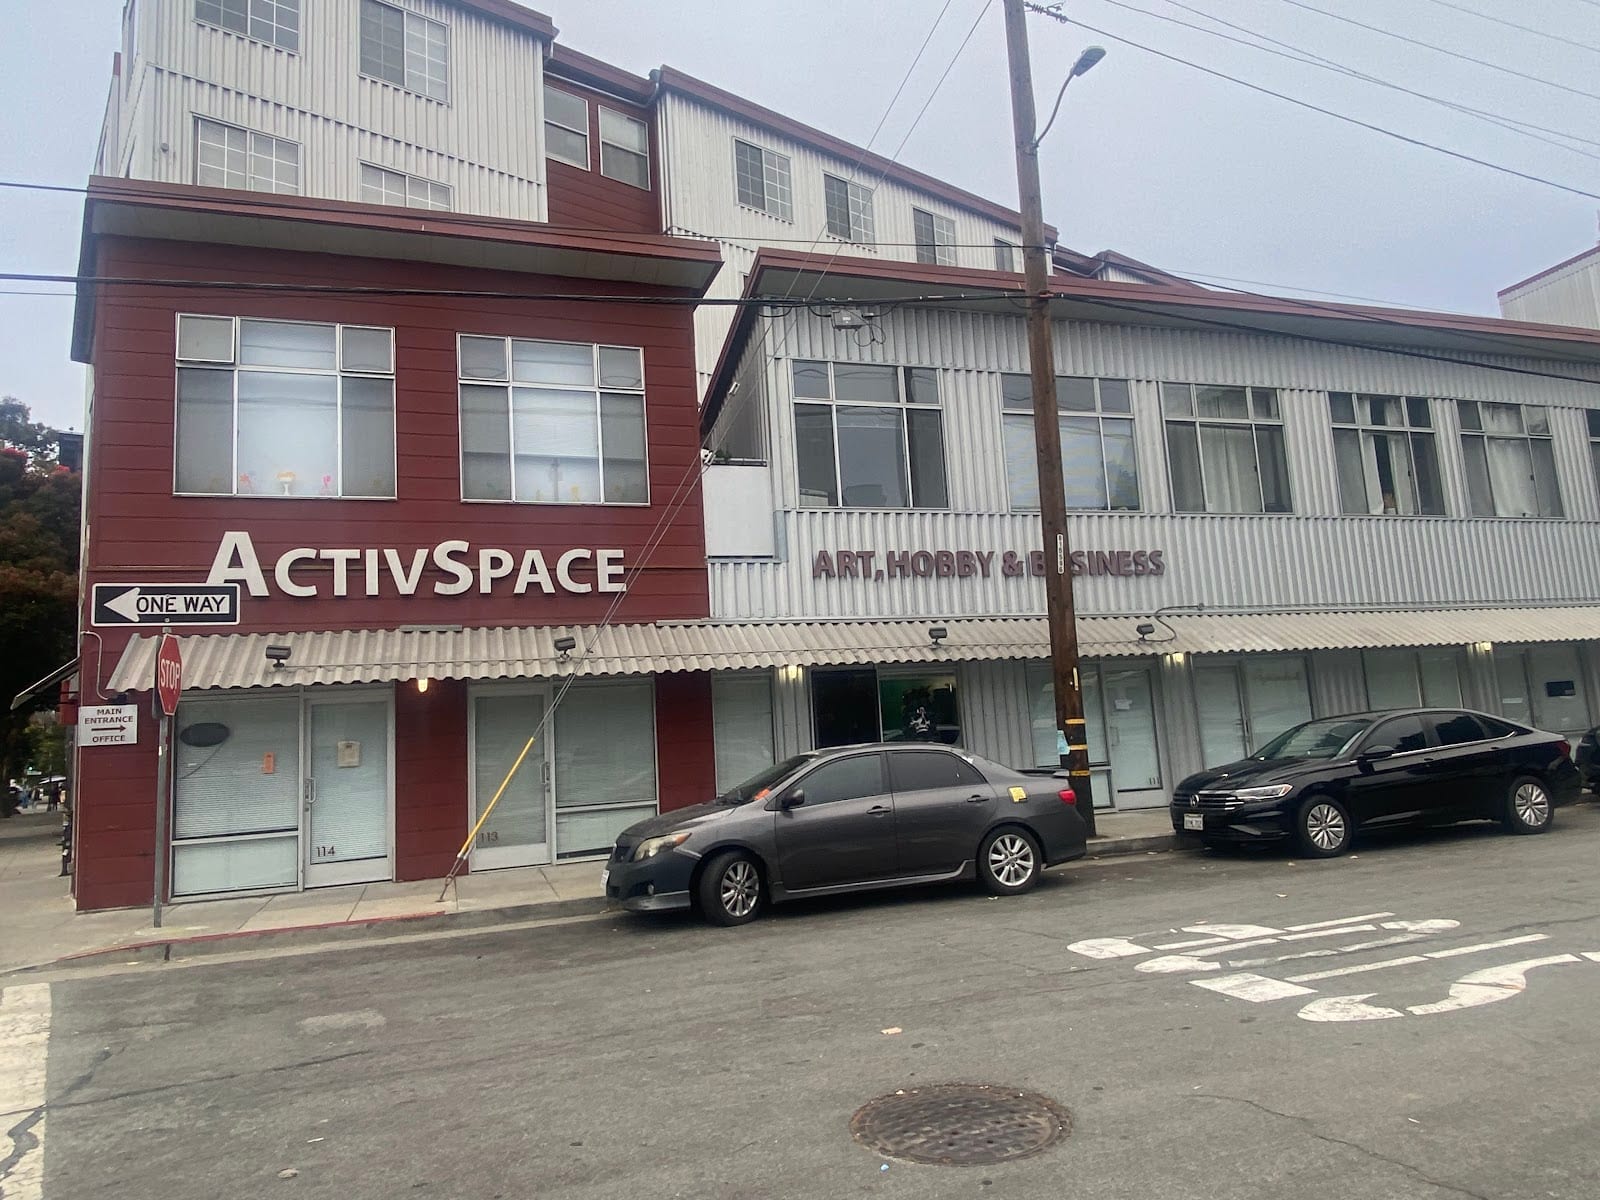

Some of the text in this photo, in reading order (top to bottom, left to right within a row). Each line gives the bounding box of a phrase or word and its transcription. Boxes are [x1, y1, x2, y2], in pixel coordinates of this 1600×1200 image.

[1002, 550, 1024, 577] &
[1031, 550, 1166, 577] BSINESS
[136, 596, 226, 613] ONE WAY
[160, 658, 181, 690] STOP
[84, 715, 134, 725] ENTRANCE
[92, 735, 126, 743] OFFICE
[316, 846, 336, 857] 114
